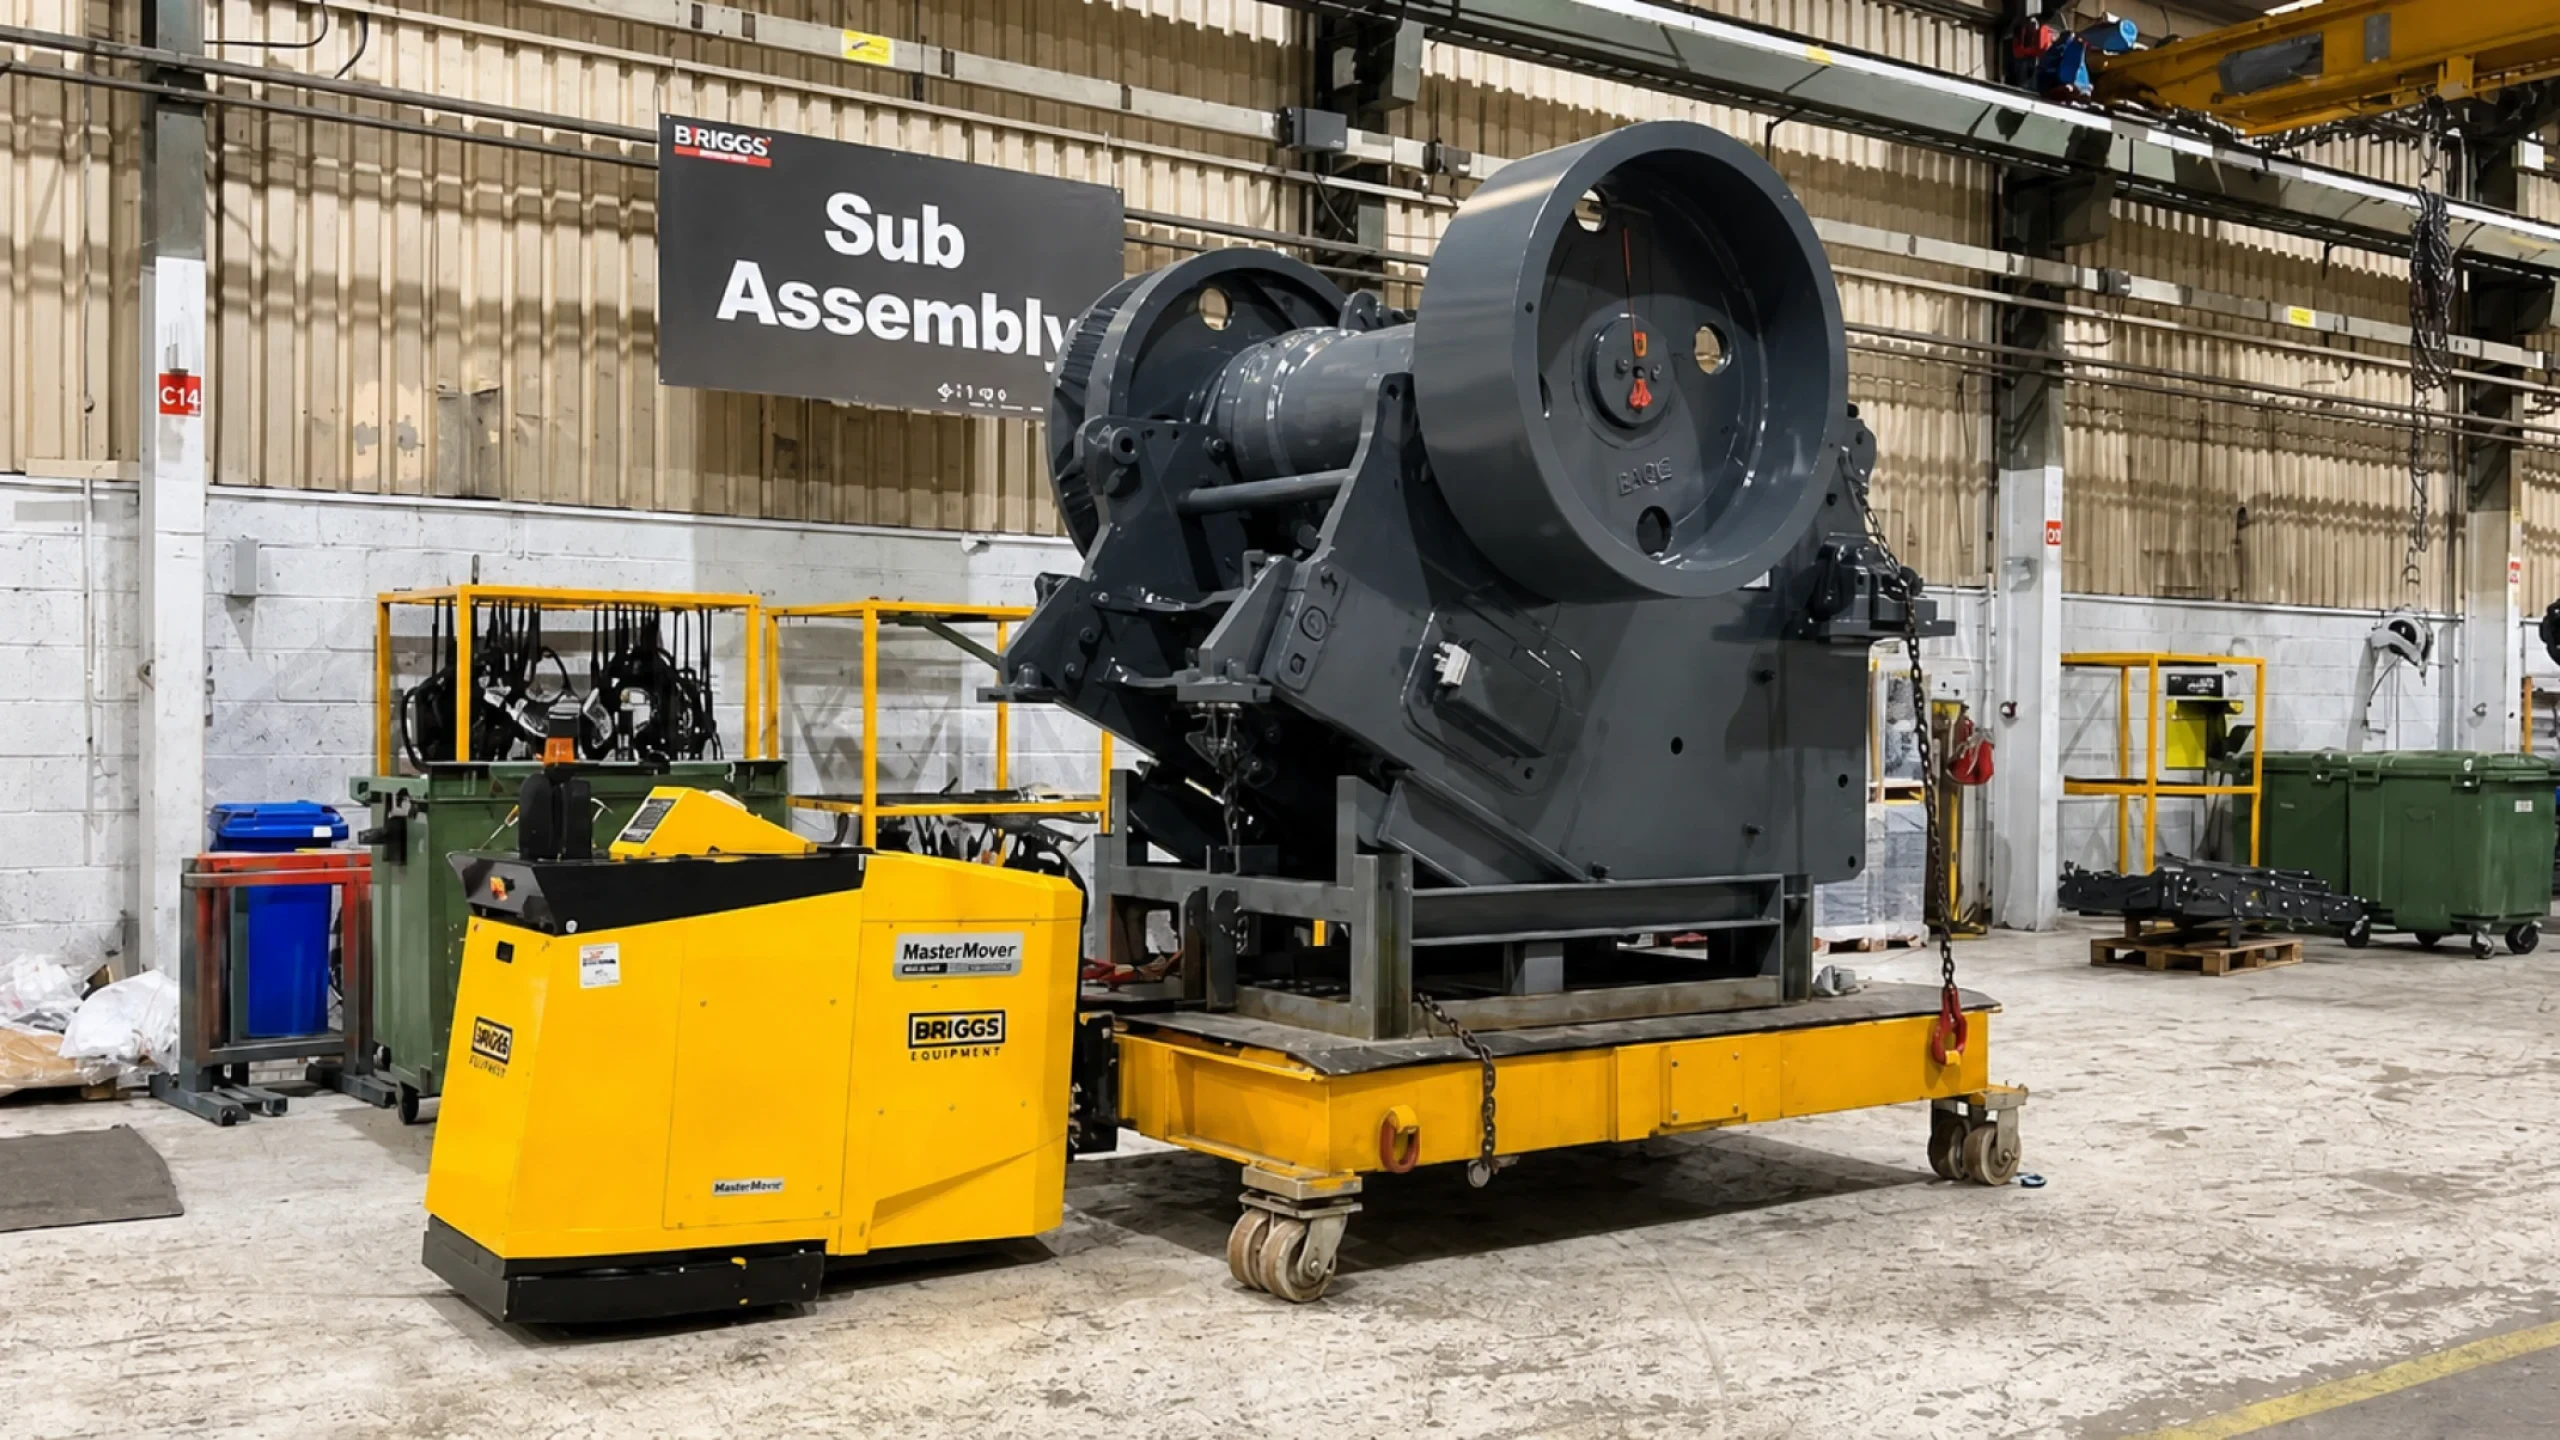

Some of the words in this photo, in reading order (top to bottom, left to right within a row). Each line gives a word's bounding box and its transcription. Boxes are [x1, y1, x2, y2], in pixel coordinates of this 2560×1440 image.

[674, 124, 768, 156] BRIGGS
[824, 192, 965, 269] Sub
[161, 386, 201, 409] C14
[903, 942, 1017, 960] MasterMover
[915, 1018, 999, 1040] BRIGGS
[910, 1047, 1000, 1061] EQUIPMENT
